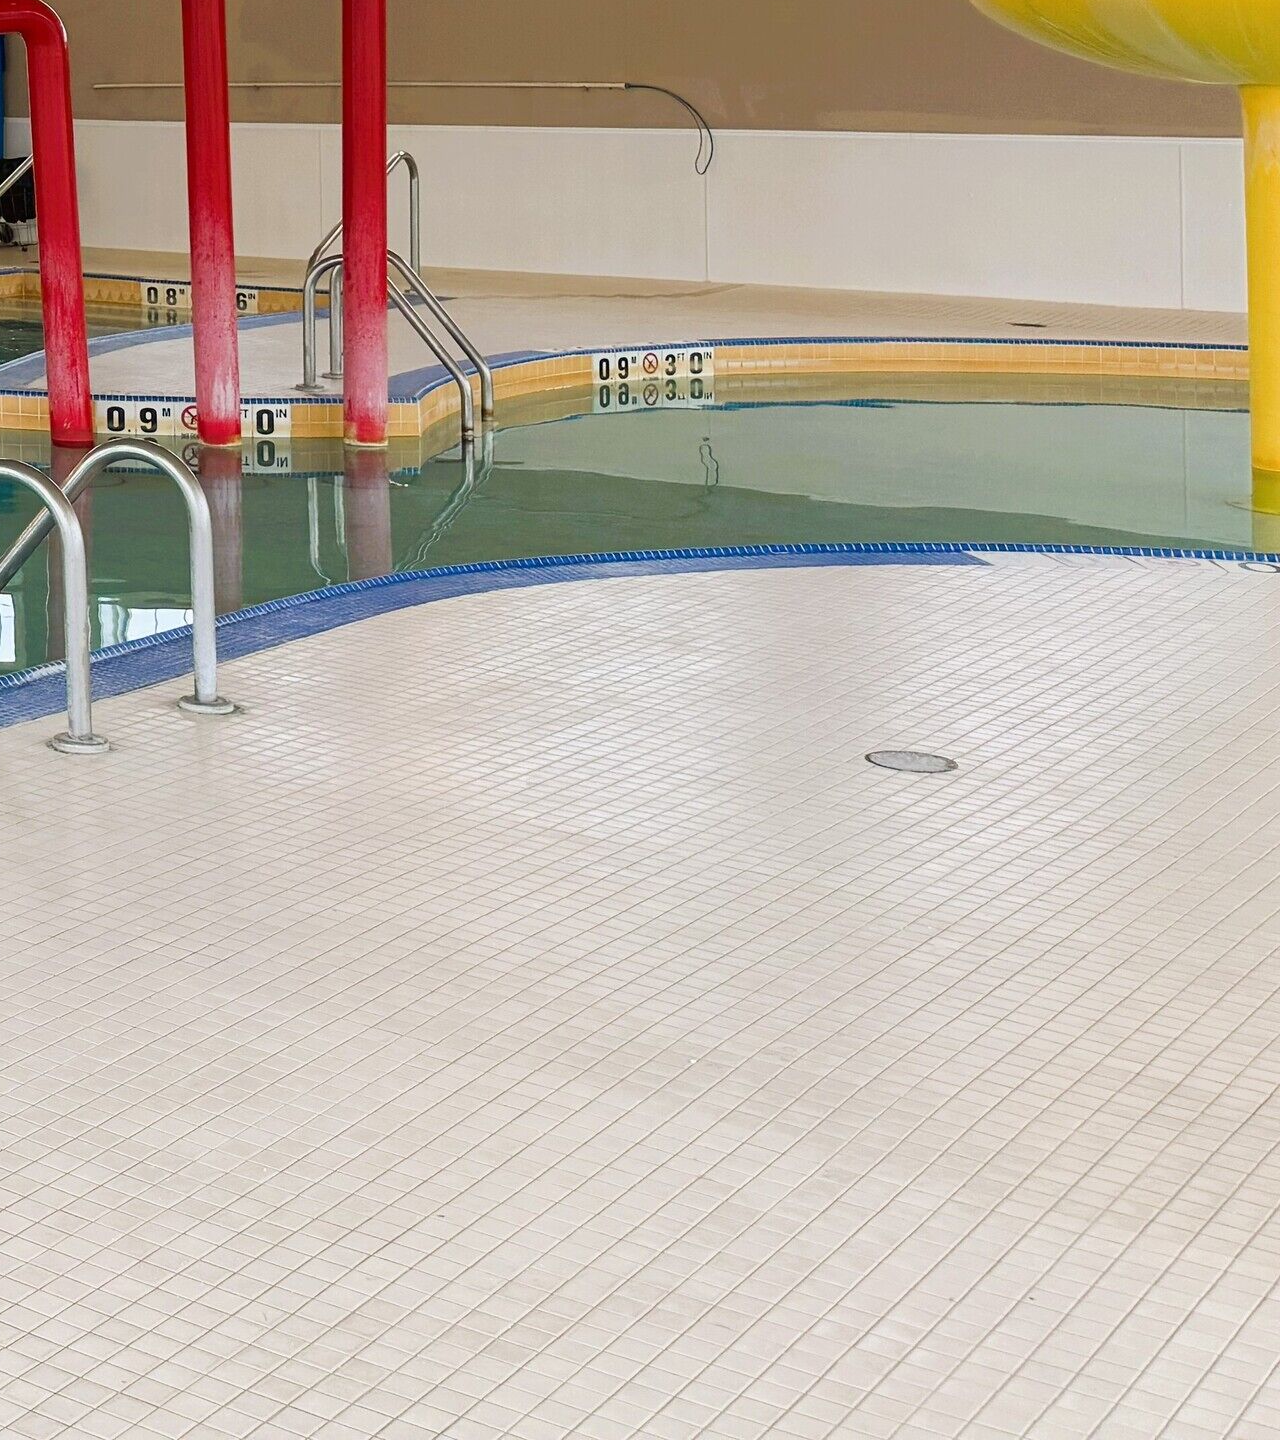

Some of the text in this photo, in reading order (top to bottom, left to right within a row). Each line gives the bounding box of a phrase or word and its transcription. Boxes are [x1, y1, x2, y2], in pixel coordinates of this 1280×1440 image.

[236, 293, 247, 311] 6
[162, 408, 171, 417] M
[256, 409, 287, 435] 0 IN
